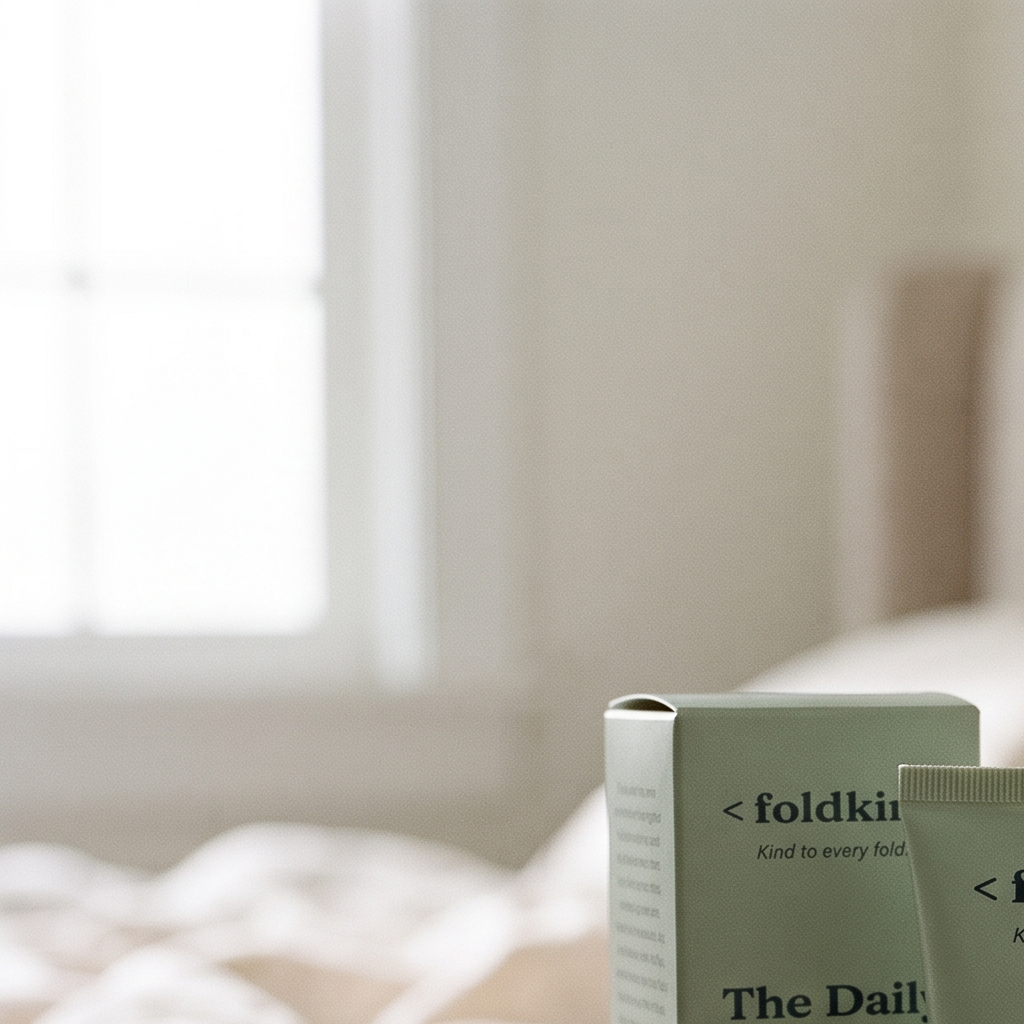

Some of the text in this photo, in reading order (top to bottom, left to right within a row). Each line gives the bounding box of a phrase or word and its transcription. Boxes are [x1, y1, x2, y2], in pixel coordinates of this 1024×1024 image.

[756, 842, 797, 860] Kind
[800, 844, 818, 860] to
[821, 845, 869, 862] every
[722, 985, 812, 1021] The
